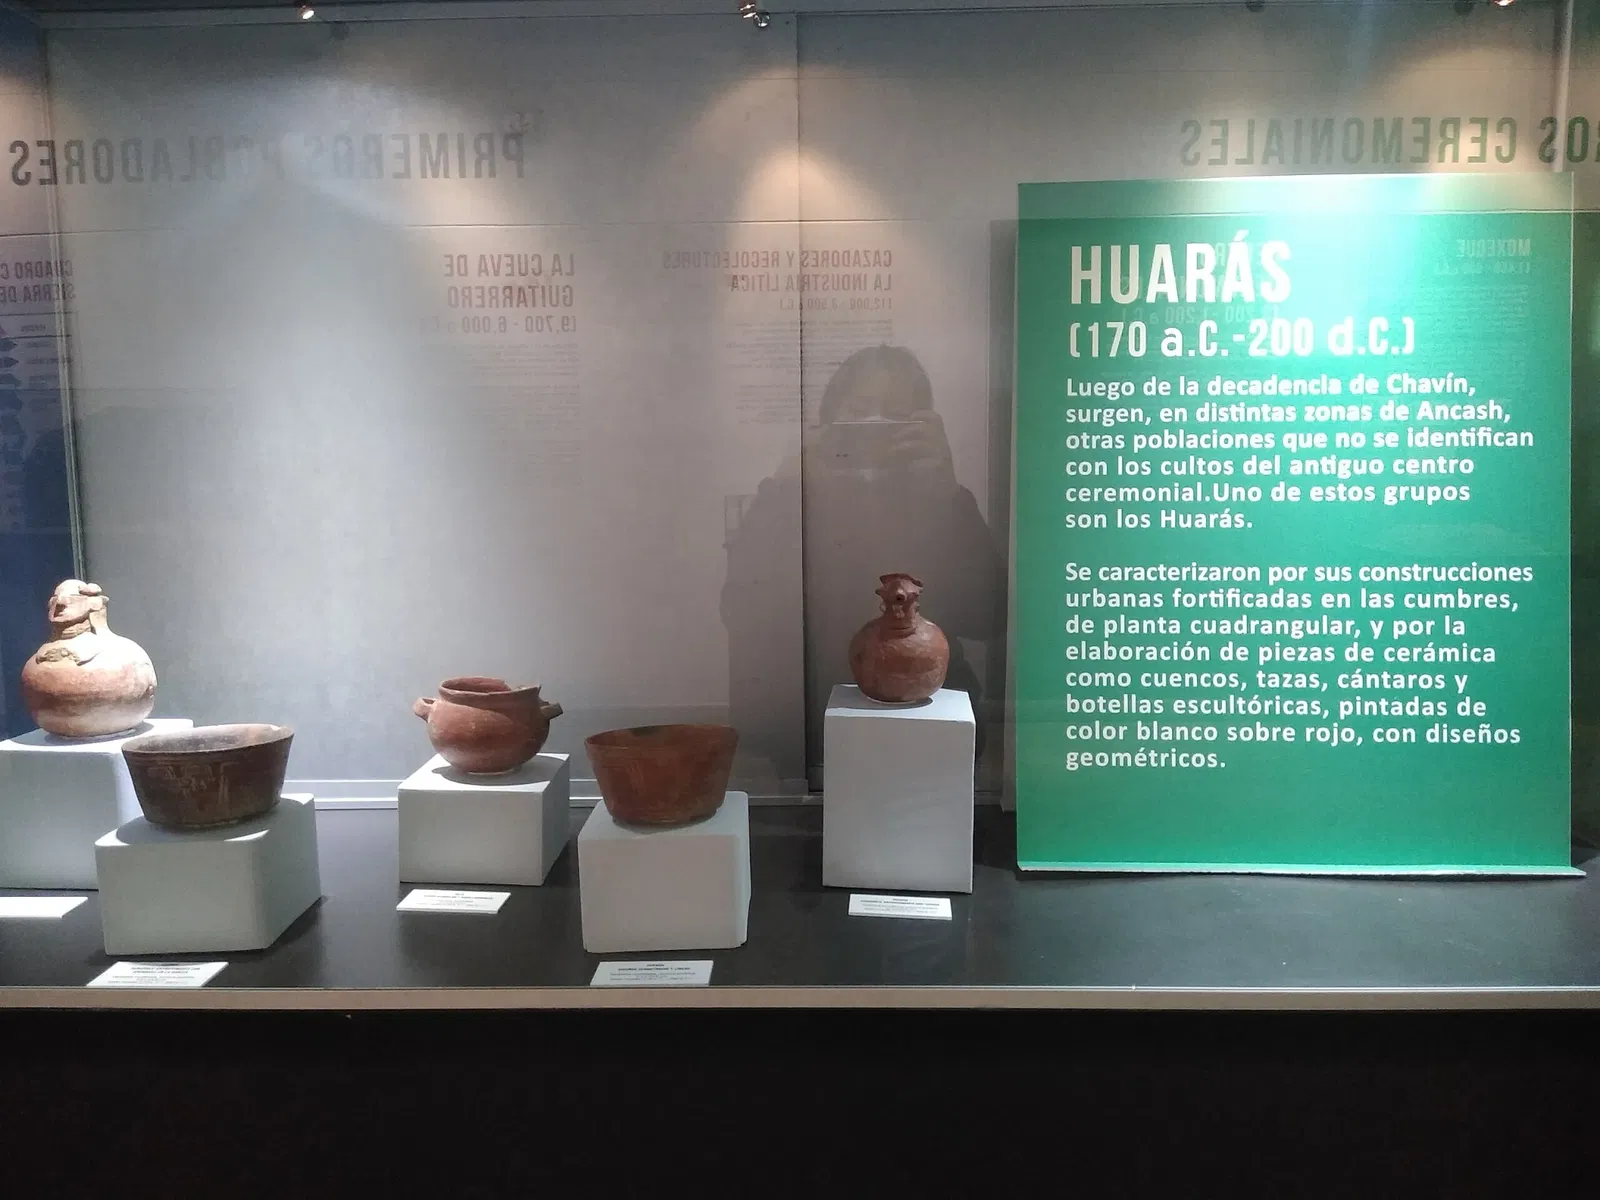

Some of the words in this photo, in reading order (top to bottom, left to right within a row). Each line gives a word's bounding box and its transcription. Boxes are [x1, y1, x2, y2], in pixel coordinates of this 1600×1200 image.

[1071, 230, 1292, 304] HUARÁS
[1070, 321, 1147, 358] (170
[1327, 316, 1415, 356] d.C.)
[1066, 379, 1136, 400] Luego
[1142, 376, 1172, 395] de
[1179, 376, 1200, 396] la
[1206, 374, 1343, 395] decadencia
[1348, 373, 1380, 394] de
[1385, 372, 1476, 396] Chavín,
[1065, 408, 1152, 427] surgen,
[1159, 408, 1188, 422] en
[1195, 402, 1297, 422] distintas
[1303, 405, 1373, 422] zonas
[1378, 399, 1410, 421] de
[1415, 400, 1511, 423] Ancash,
[1065, 432, 1126, 449] otras
[1133, 429, 1276, 453] poblaciones
[1281, 432, 1329, 452] que
[1334, 432, 1367, 448] no
[1372, 432, 1400, 447] se
[1407, 427, 1534, 447] identifican
[1065, 461, 1108, 475] con
[1117, 456, 1152, 475] los
[1160, 456, 1235, 475] cultos
[1242, 455, 1281, 475] del
[1289, 454, 1385, 479] antiguo
[1392, 456, 1475, 474] centro
[1270, 481, 1302, 502] de
[1309, 483, 1376, 502] estos
[1383, 486, 1471, 506] grupos
[1065, 514, 1107, 528] son
[1116, 509, 1152, 528] los
[1160, 508, 1253, 528] Huarás.
[1065, 563, 1092, 581] Se
[1098, 562, 1261, 581] caracterizaron
[1268, 566, 1309, 586] por
[1313, 566, 1353, 582] sus
[1358, 562, 1534, 582] construcciones
[1065, 588, 1164, 607] urbanas
[1171, 588, 1313, 608] fortificadas
[1320, 593, 1351, 608] en
[1360, 588, 1395, 608] las
[1403, 588, 1519, 612] cumbres,
[1065, 614, 1095, 633] de
[1103, 614, 1181, 638] planta
[1189, 614, 1361, 639] cuadrangular,
[1369, 620, 1385, 639] y
[1392, 620, 1436, 639] por
[1444, 615, 1466, 635] la
[1065, 641, 1210, 661] elaboración
[1219, 641, 1250, 661] de
[1258, 642, 1336, 665] piezas
[1344, 642, 1375, 662] de
[1383, 642, 1496, 662] cerámica
[1065, 672, 1132, 687] como
[1140, 673, 1248, 691] cuencos,
[1255, 670, 1329, 692] tazas,
[1337, 668, 1446, 689] cántaros
[1453, 675, 1469, 694] y
[1066, 694, 1165, 713] botellas
[1172, 695, 1330, 719] escultóricas,
[1339, 696, 1448, 720] pintadas
[1456, 696, 1487, 716] de
[1065, 720, 1128, 740] color
[1136, 721, 1218, 741] blanco
[1226, 721, 1296, 742] sobre
[1305, 722, 1364, 747] rojo,
[1372, 728, 1416, 742] con
[1425, 723, 1521, 743] diseños
[1065, 747, 1226, 770] geométricos.
